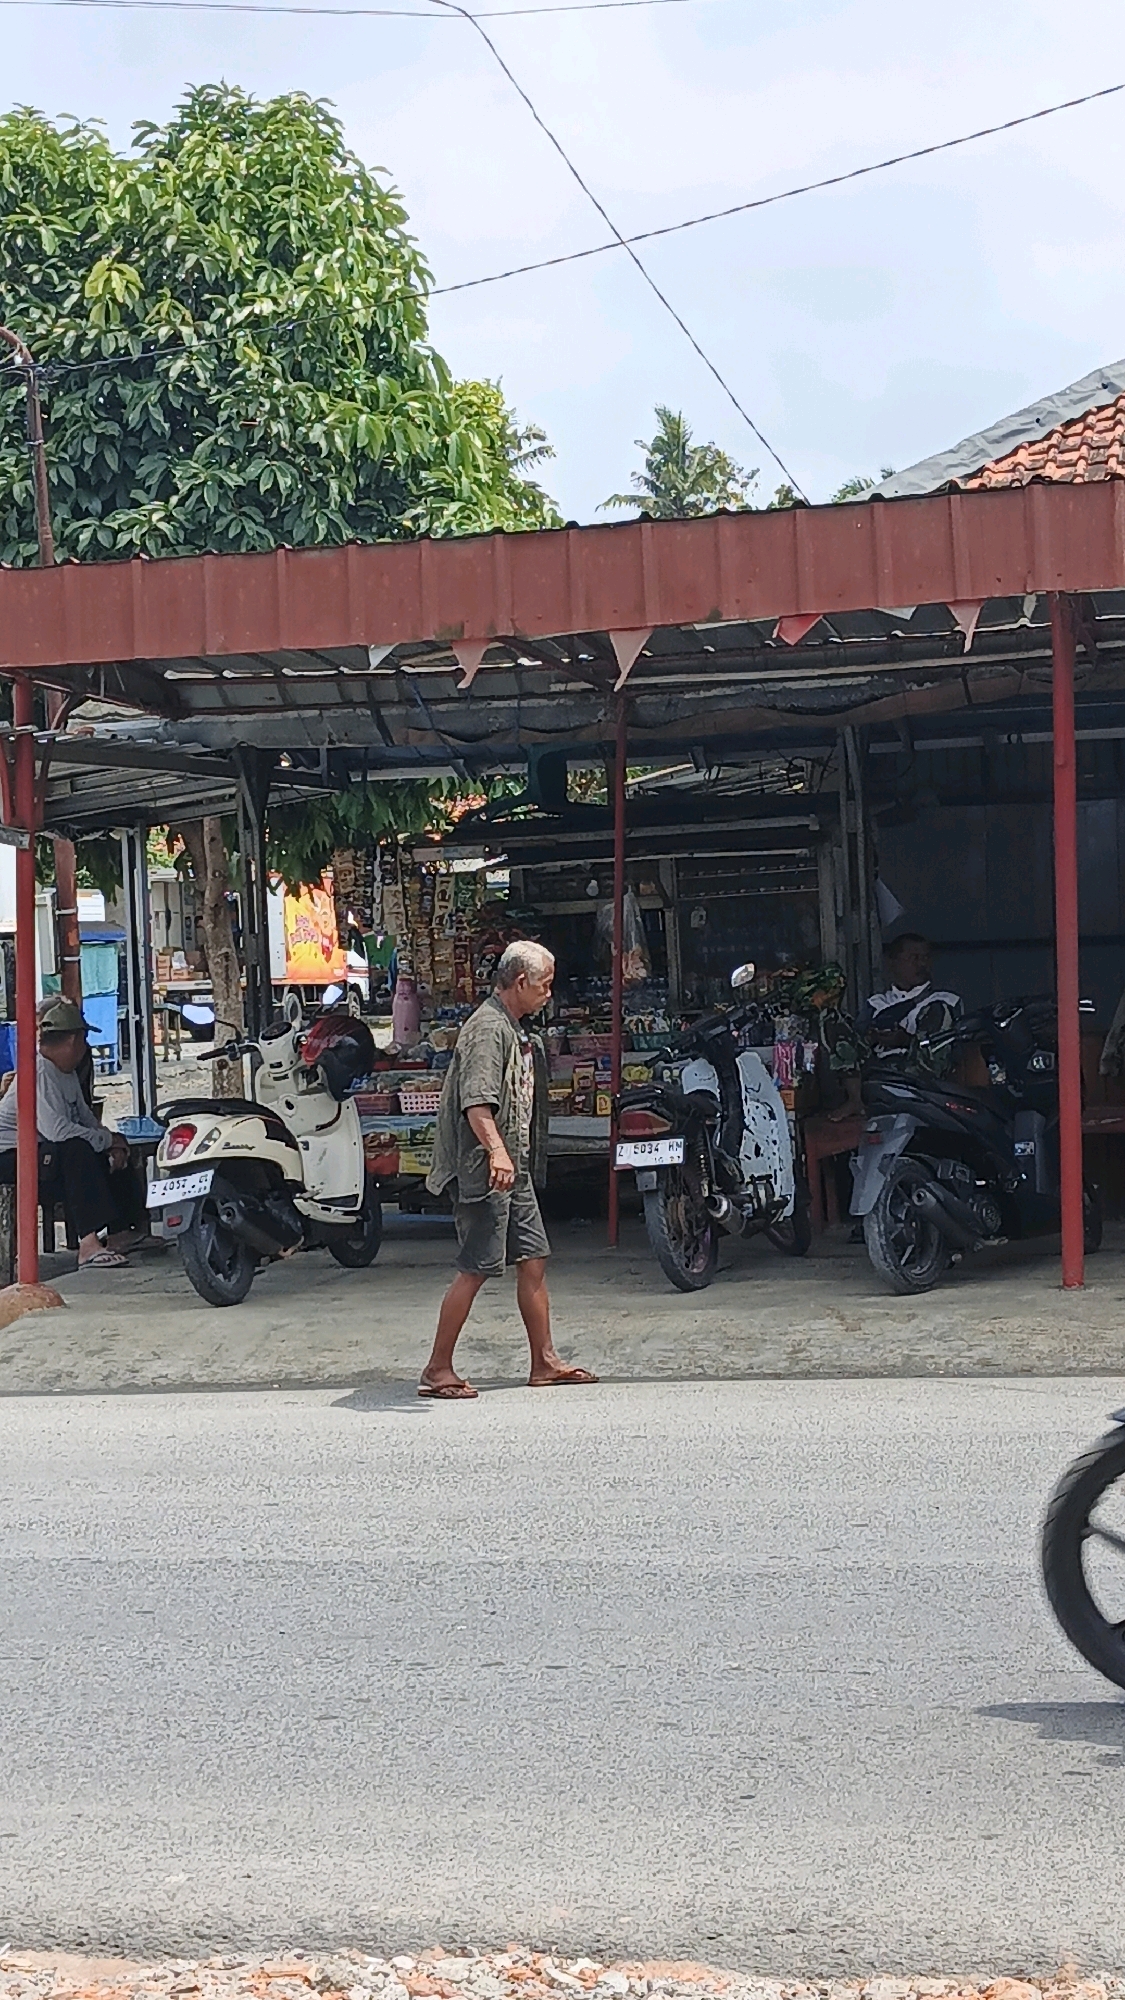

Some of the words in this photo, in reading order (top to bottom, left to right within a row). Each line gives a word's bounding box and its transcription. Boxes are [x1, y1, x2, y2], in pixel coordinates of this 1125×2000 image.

[618, 1145, 624, 1157] Z
[633, 1142, 660, 1155] 5034
[151, 1184, 157, 1195] Z
